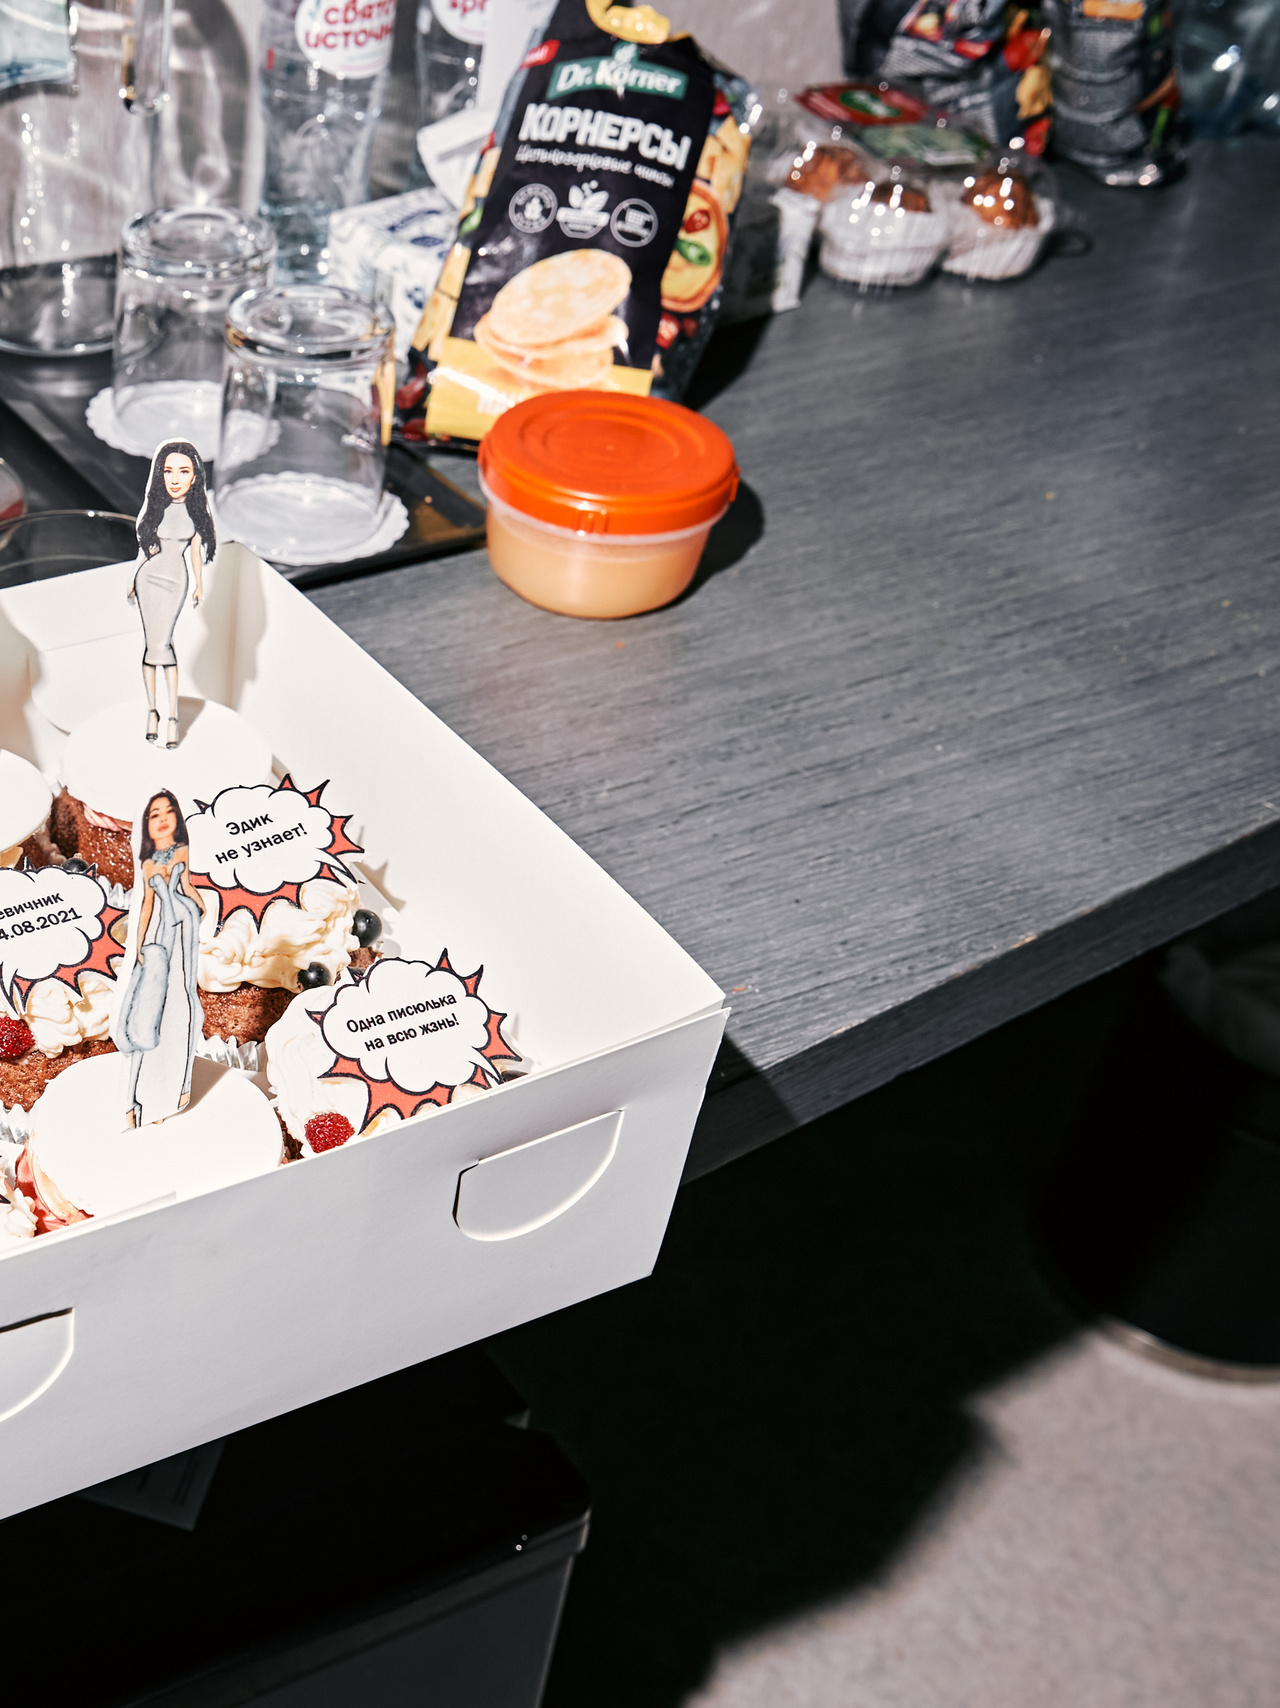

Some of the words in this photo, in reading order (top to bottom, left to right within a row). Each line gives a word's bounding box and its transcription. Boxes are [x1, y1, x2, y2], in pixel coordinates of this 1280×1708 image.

[556, 63, 593, 91] Dr.
[518, 103, 692, 171] КОРНЕРСЫ
[215, 849, 239, 864] не
[241, 822, 307, 858] узнает!
[226, 813, 273, 835] Эдик
[346, 1014, 385, 1033] Одна
[387, 994, 457, 1021] писюлька
[364, 1037, 384, 1051] на
[386, 1027, 417, 1045] всю
[419, 1013, 459, 1036] жзнь!
